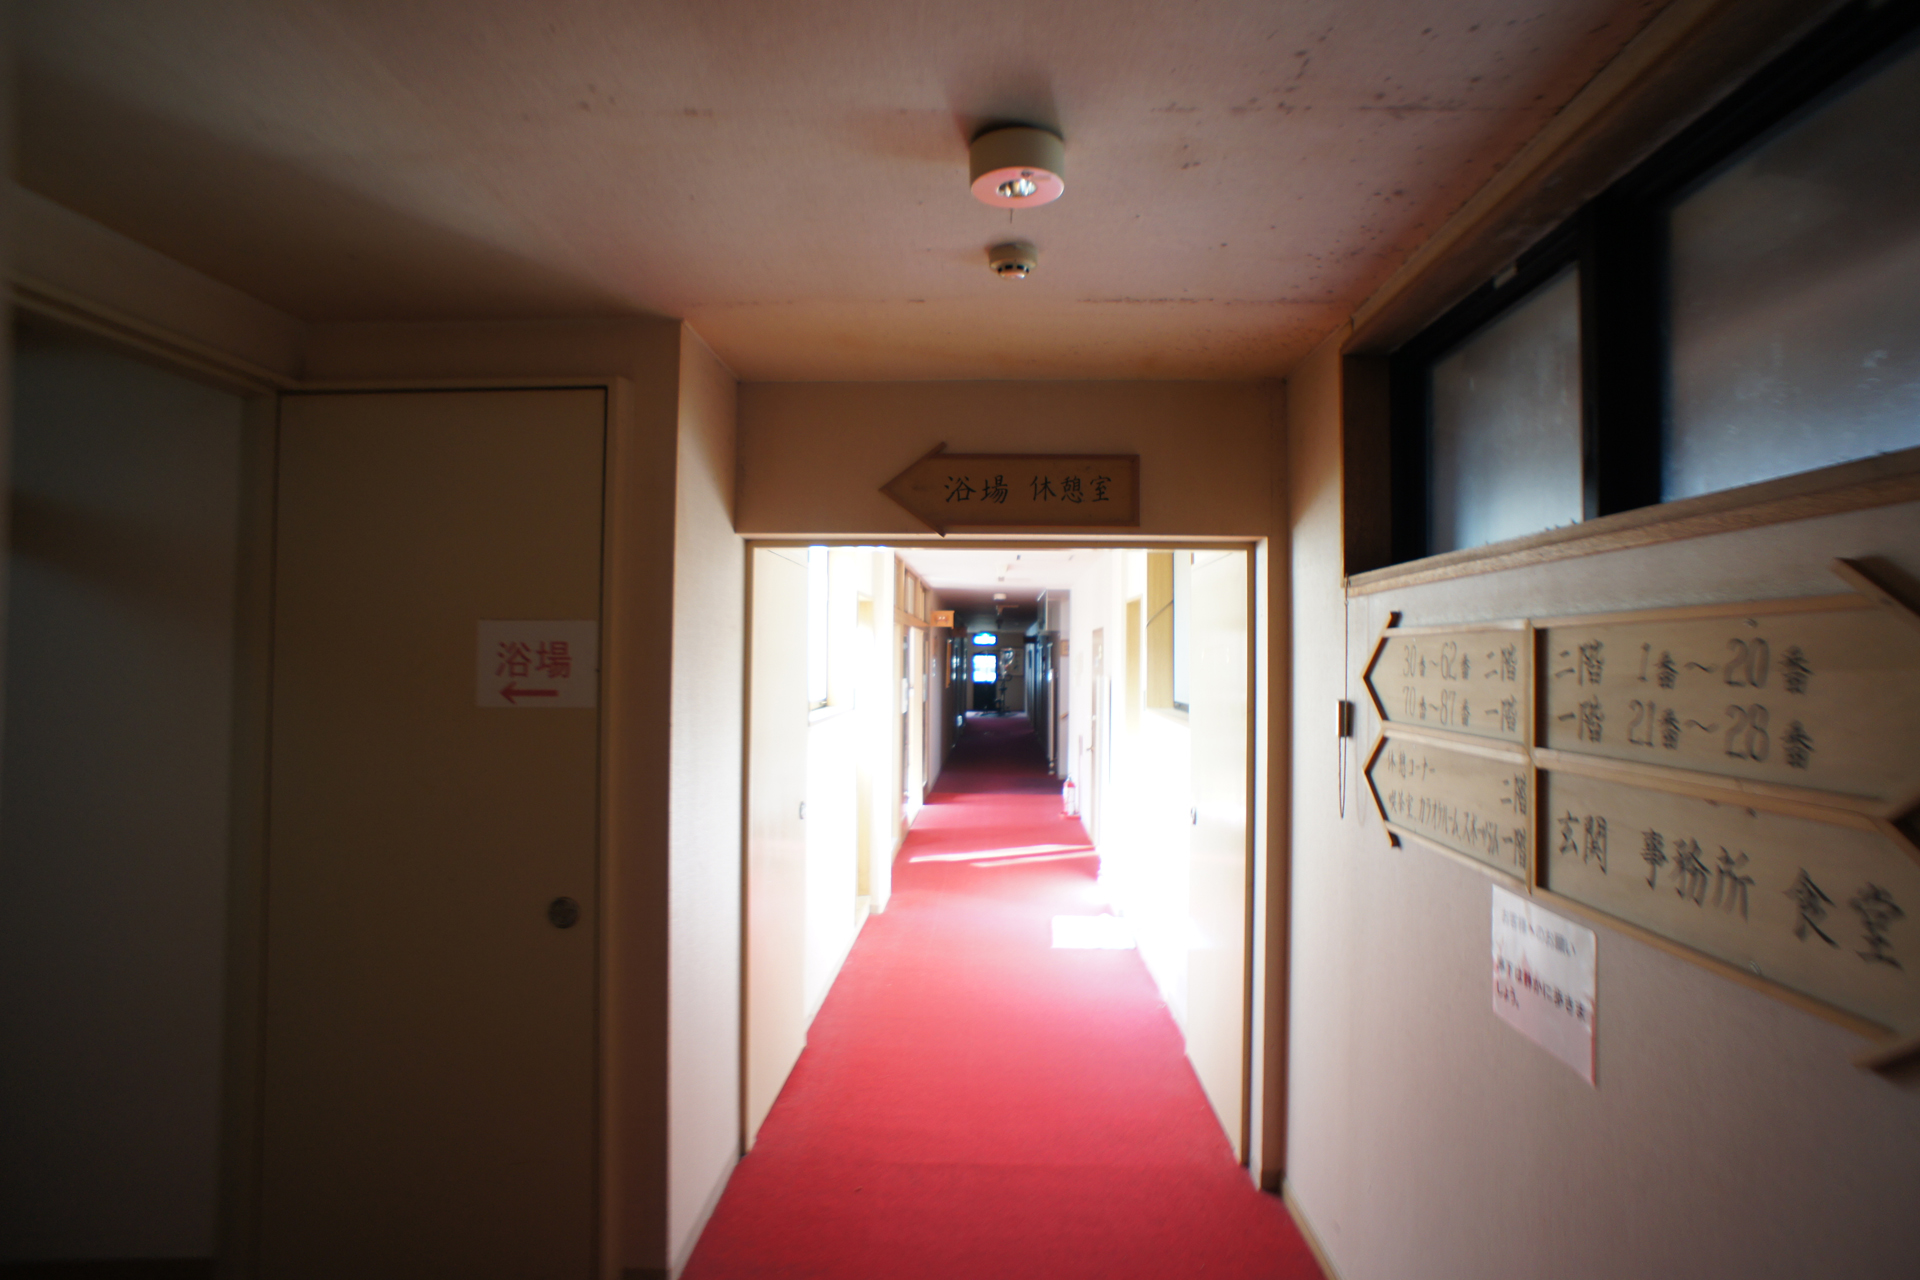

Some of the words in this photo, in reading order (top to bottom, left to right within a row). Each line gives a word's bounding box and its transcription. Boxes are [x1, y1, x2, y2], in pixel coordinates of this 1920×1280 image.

[944, 474, 1008, 504] 浴場
[1029, 475, 1112, 504] 休憩室
[495, 640, 572, 679] 浴場
[1555, 639, 1604, 686] 二階
[1557, 695, 1606, 743] 一階
[1557, 810, 1608, 876] 玄関
[1640, 827, 1755, 922] 事務所
[1782, 866, 1906, 971] 食堂
